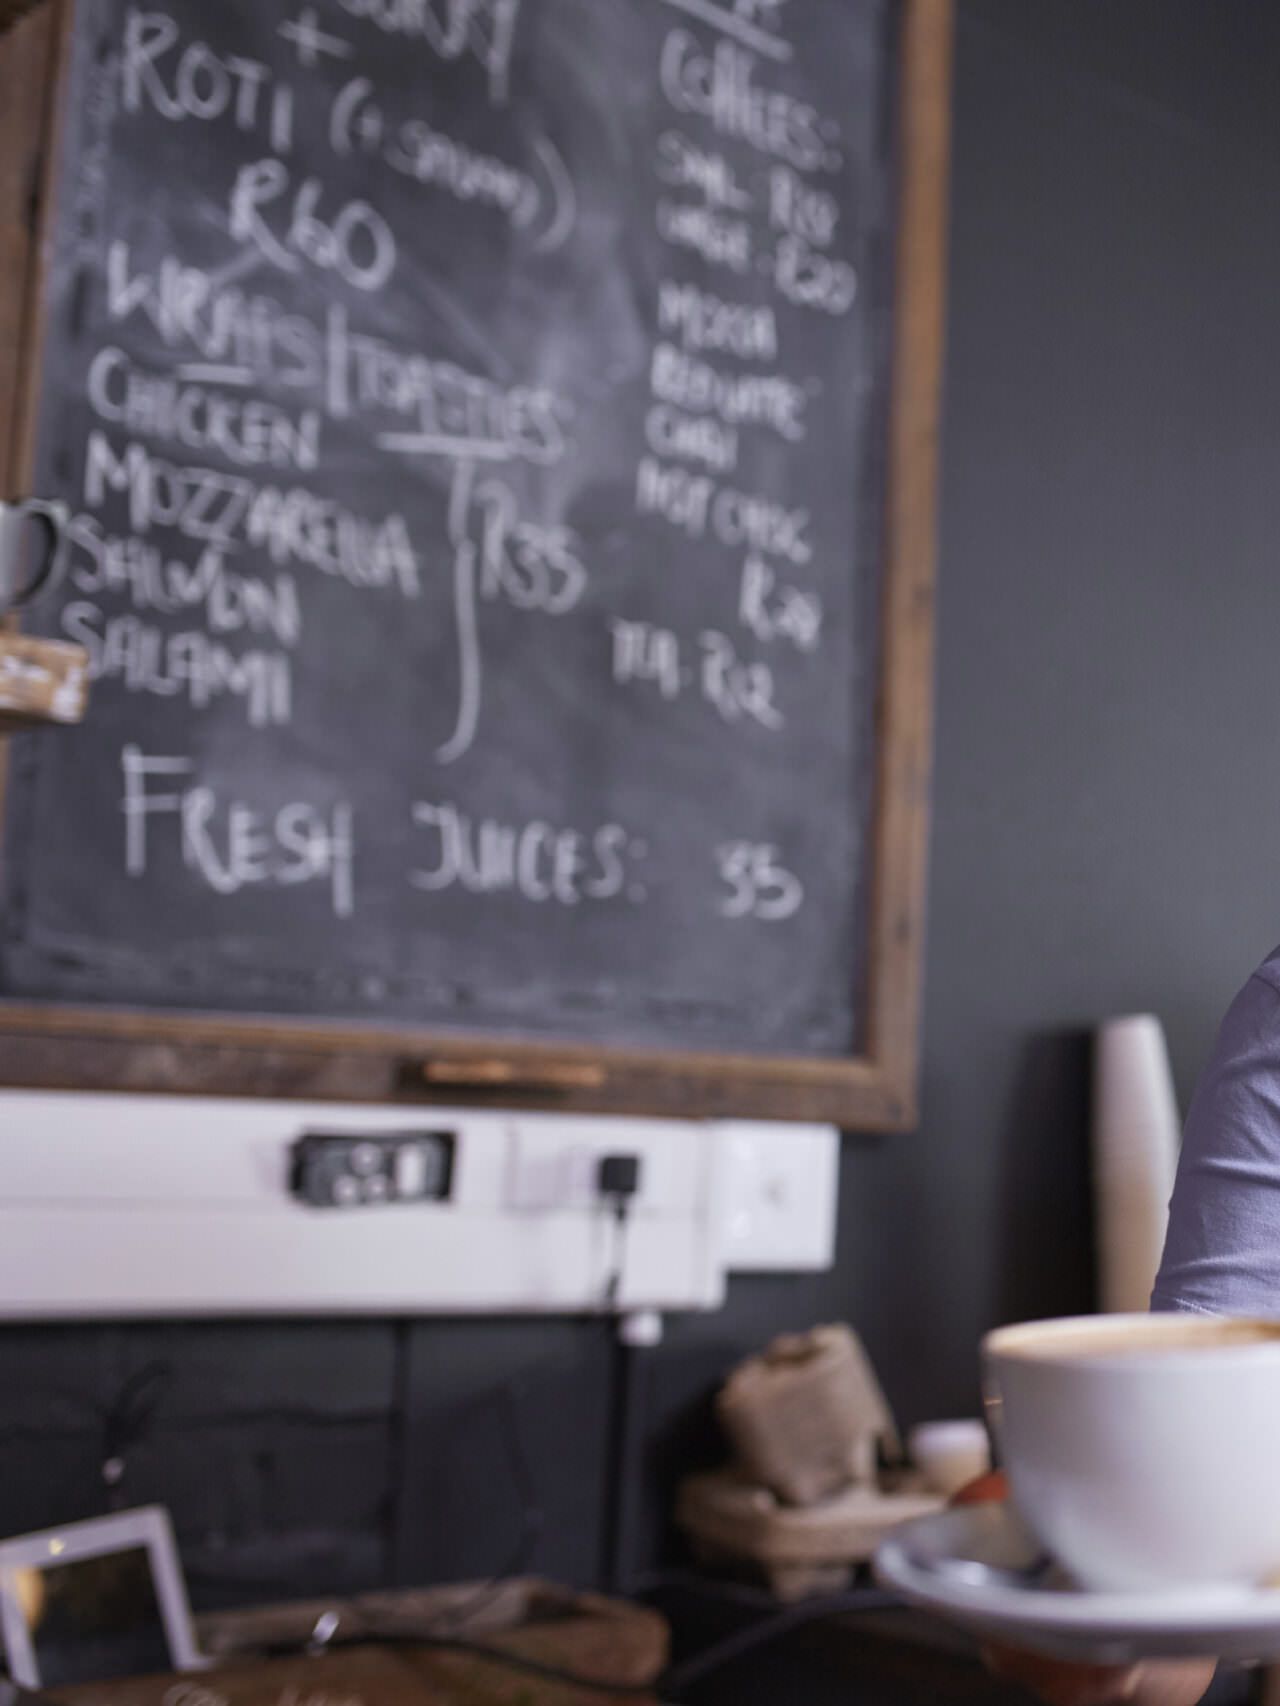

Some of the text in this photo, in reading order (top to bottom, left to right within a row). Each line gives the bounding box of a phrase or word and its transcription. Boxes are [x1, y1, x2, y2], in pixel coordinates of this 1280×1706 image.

[122, 7, 293, 153] ROTI
[229, 157, 397, 291] R60
[88, 345, 320, 470] CHICKEN
[63, 510, 298, 645] SALMON
[83, 428, 420, 599] MOZZARELLA
[62, 600, 292, 727] SALAMI
[121, 744, 354, 918] FRESH
